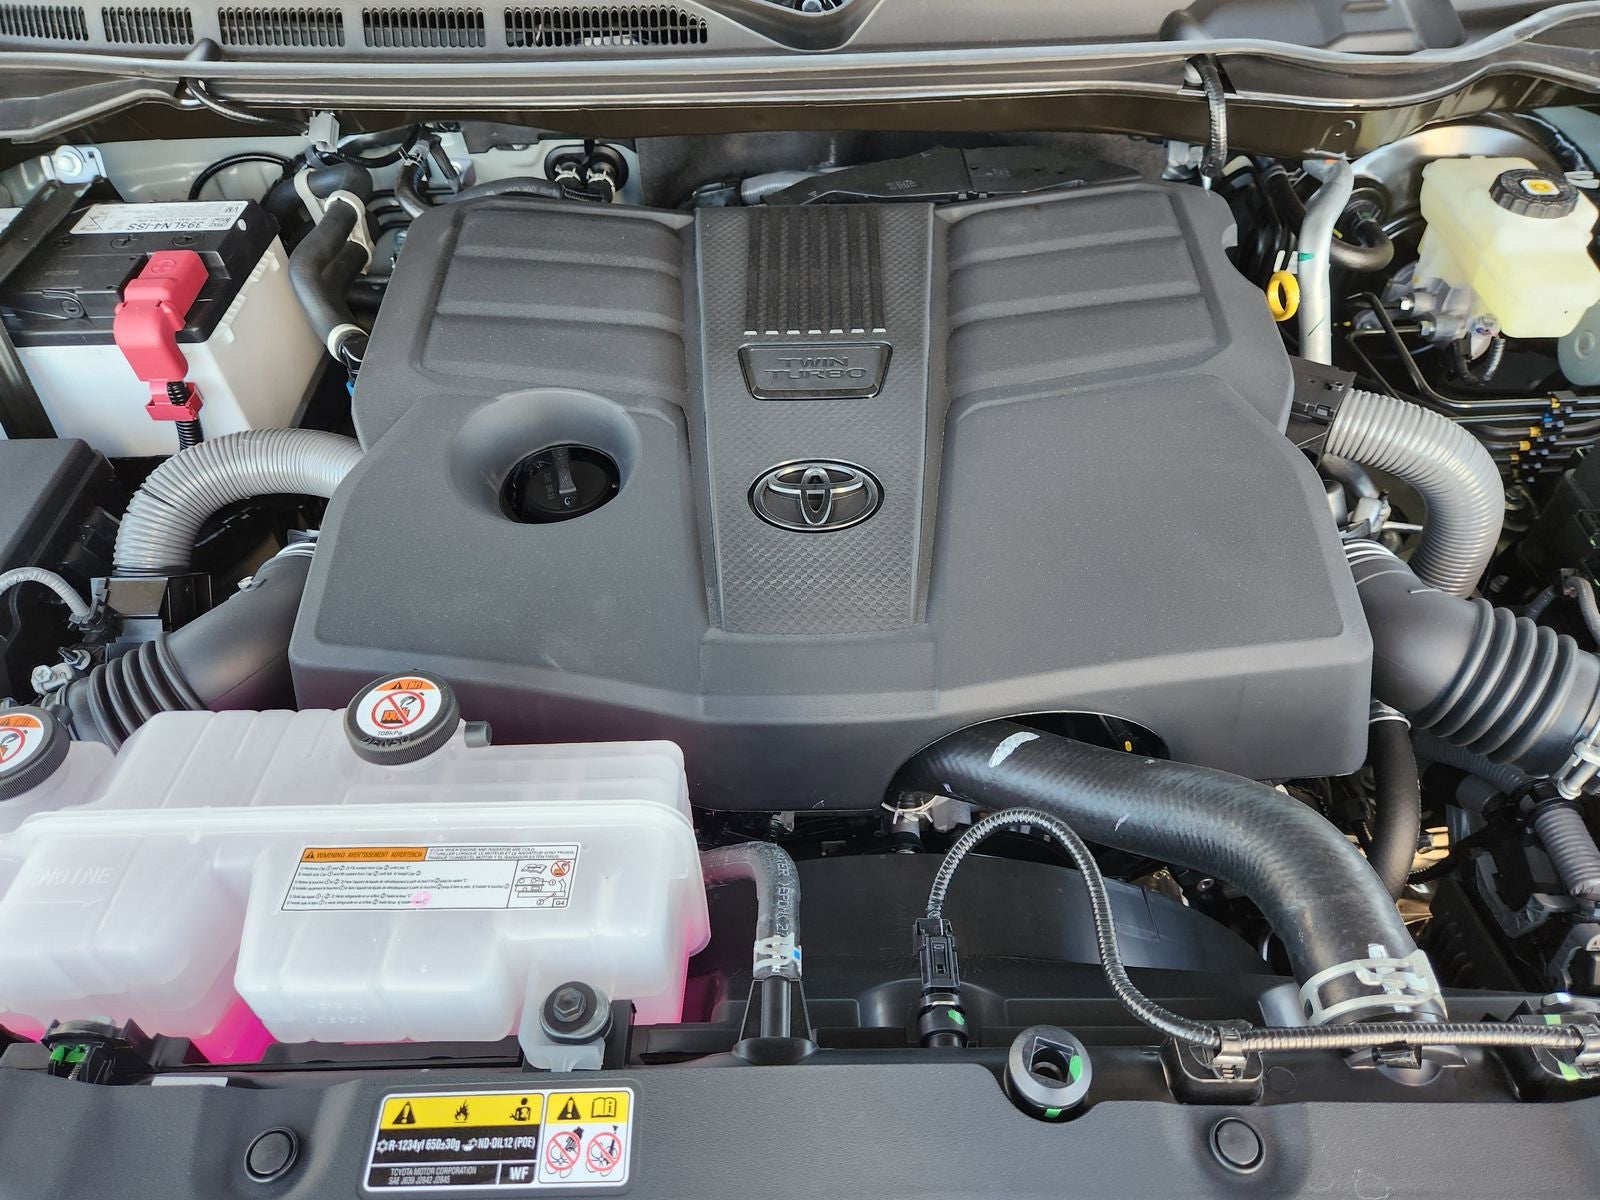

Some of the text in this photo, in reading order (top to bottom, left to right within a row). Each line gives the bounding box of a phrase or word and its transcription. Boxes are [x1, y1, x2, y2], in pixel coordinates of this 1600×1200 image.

[776, 356, 849, 368] TWIN
[763, 367, 867, 379] TURBO
[317, 851, 345, 859] WARNING
[388, 1138, 425, 1153] R-1234yf
[426, 1138, 461, 1151] 650±30g
[514, 1136, 536, 1150] (POE)
[390, 1166, 477, 1176] TOYOTA MOTOR CORPORATION
[509, 1166, 530, 1182] WF
[388, 1176, 400, 1185] SAE
